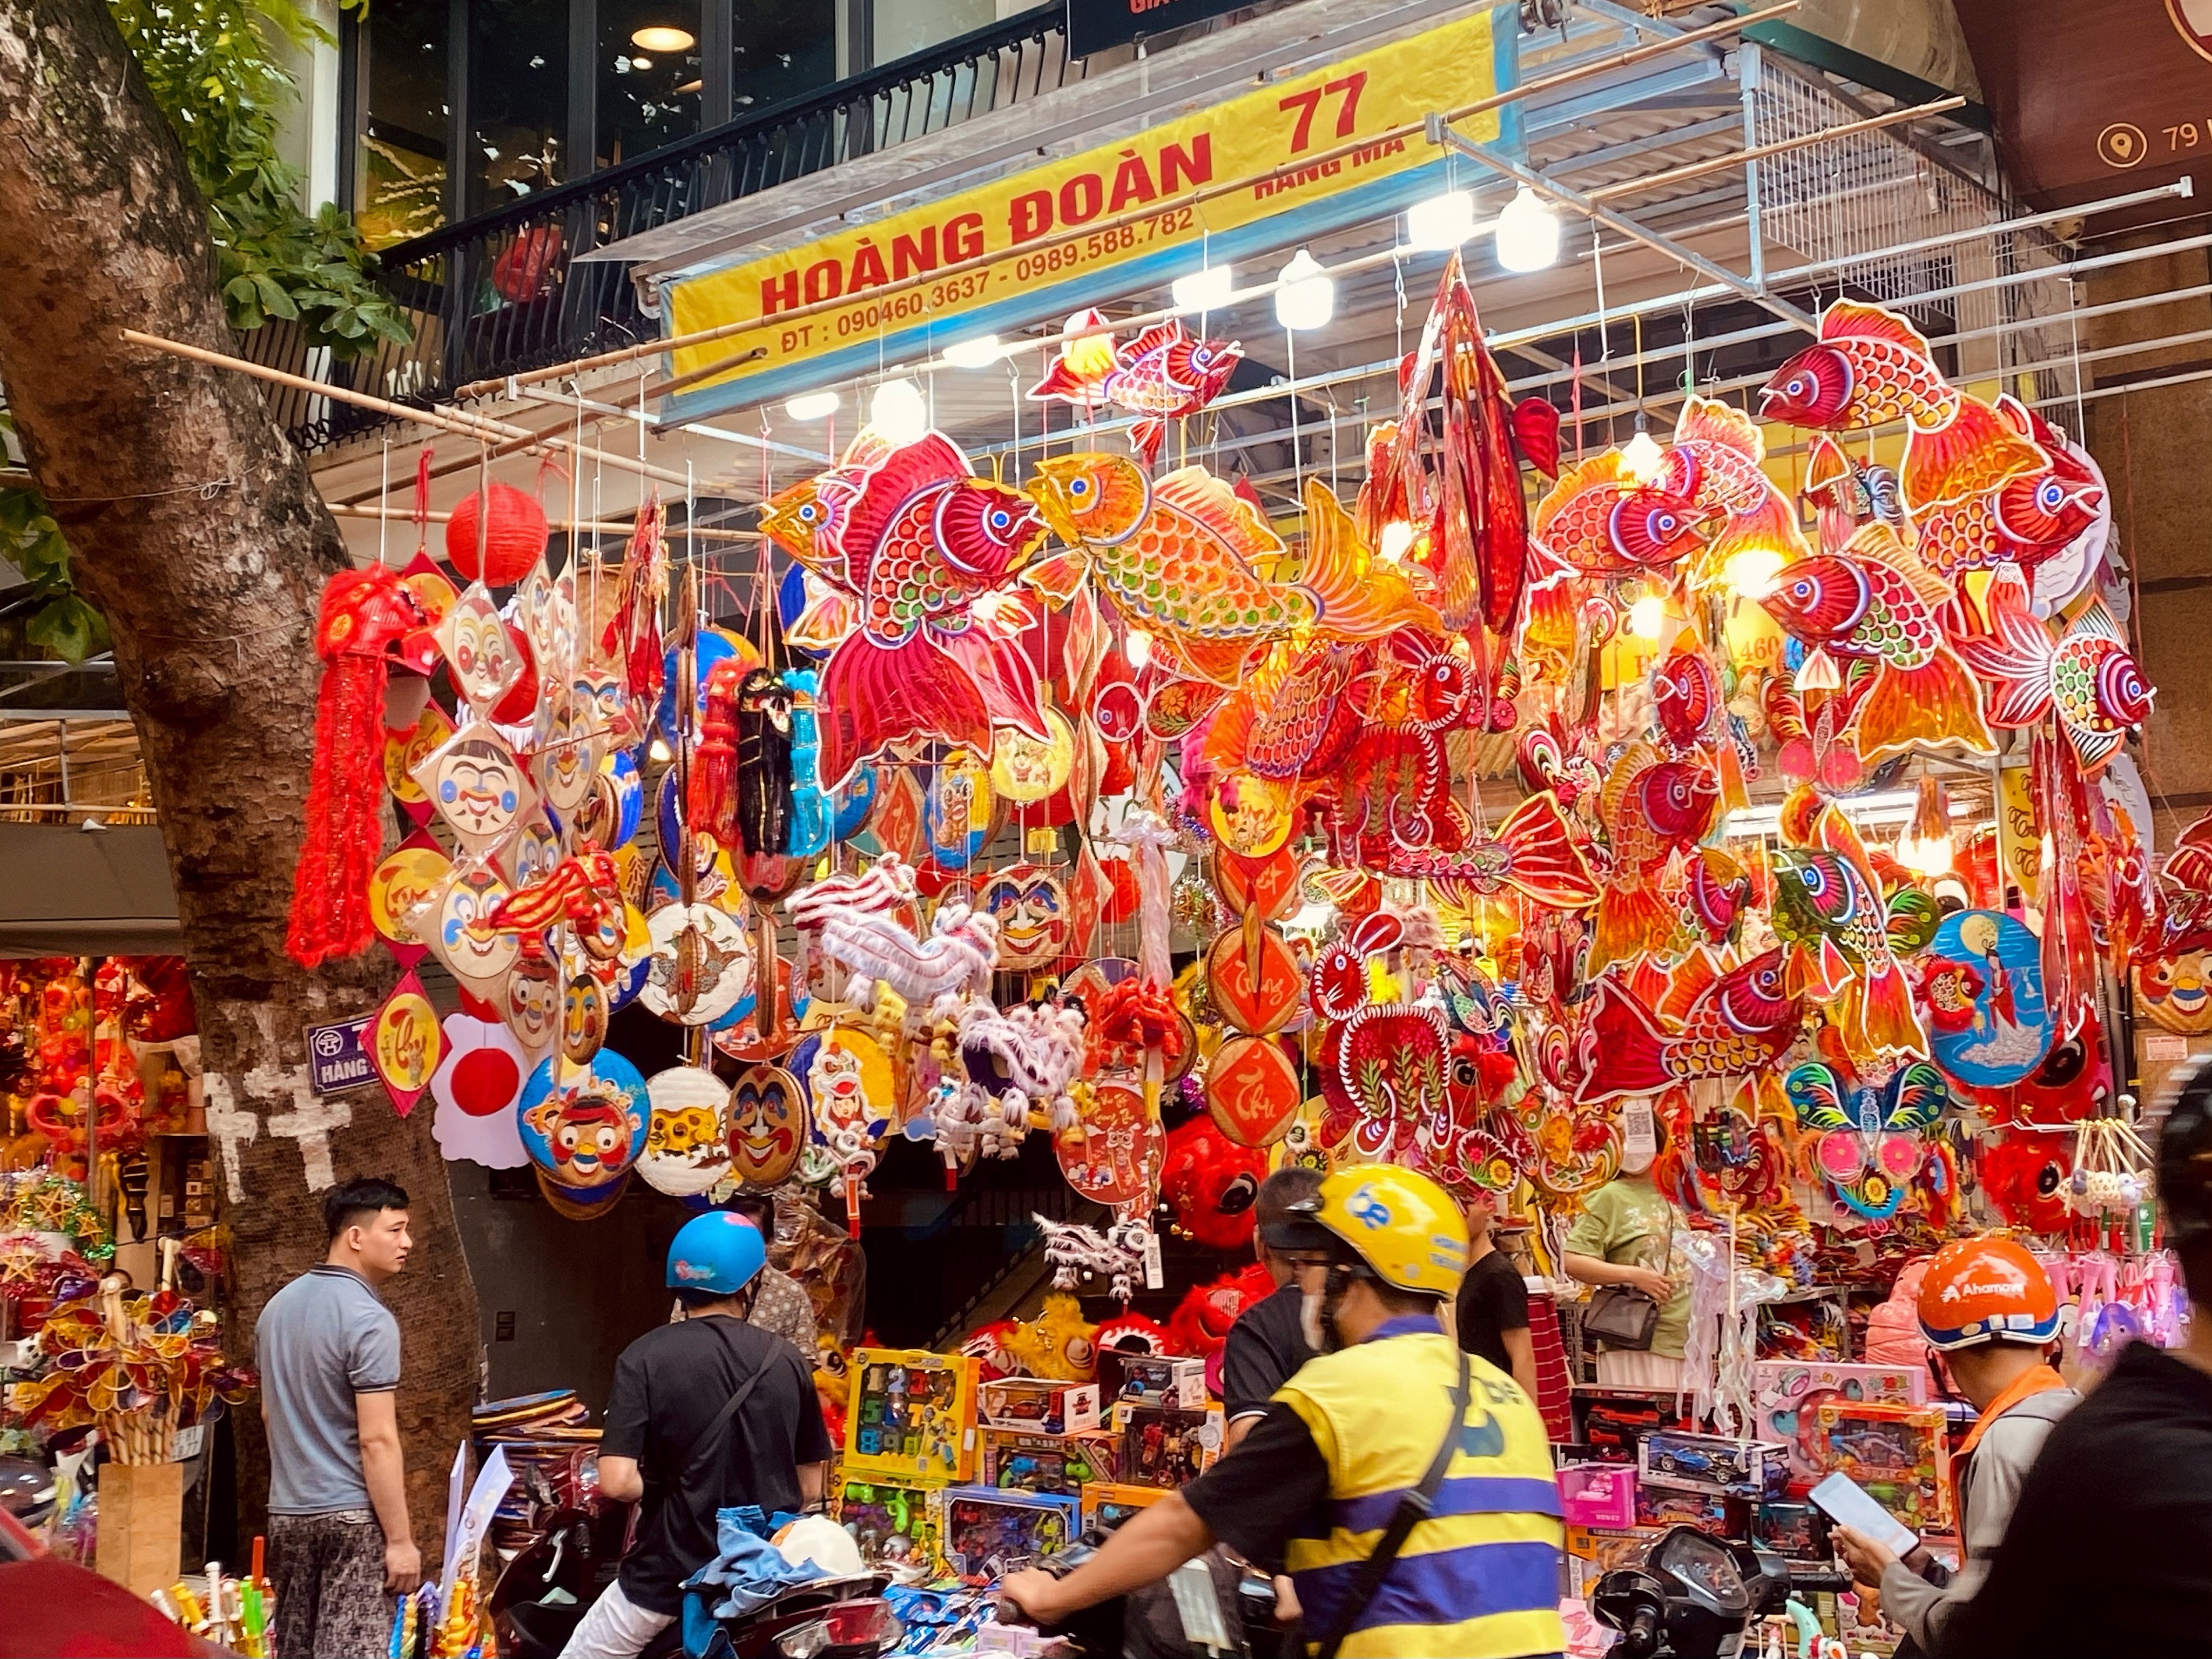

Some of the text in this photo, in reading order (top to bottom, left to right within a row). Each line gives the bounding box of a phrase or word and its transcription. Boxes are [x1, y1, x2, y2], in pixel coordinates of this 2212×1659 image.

[2162, 123, 2198, 151] 79
[761, 71, 1367, 315] HOÀNG ĐOÀN 77
[781, 325, 813, 353] ĐT
[1016, 207, 1193, 281] 0989.588.782
[321, 1058, 368, 1083] HÀNG
